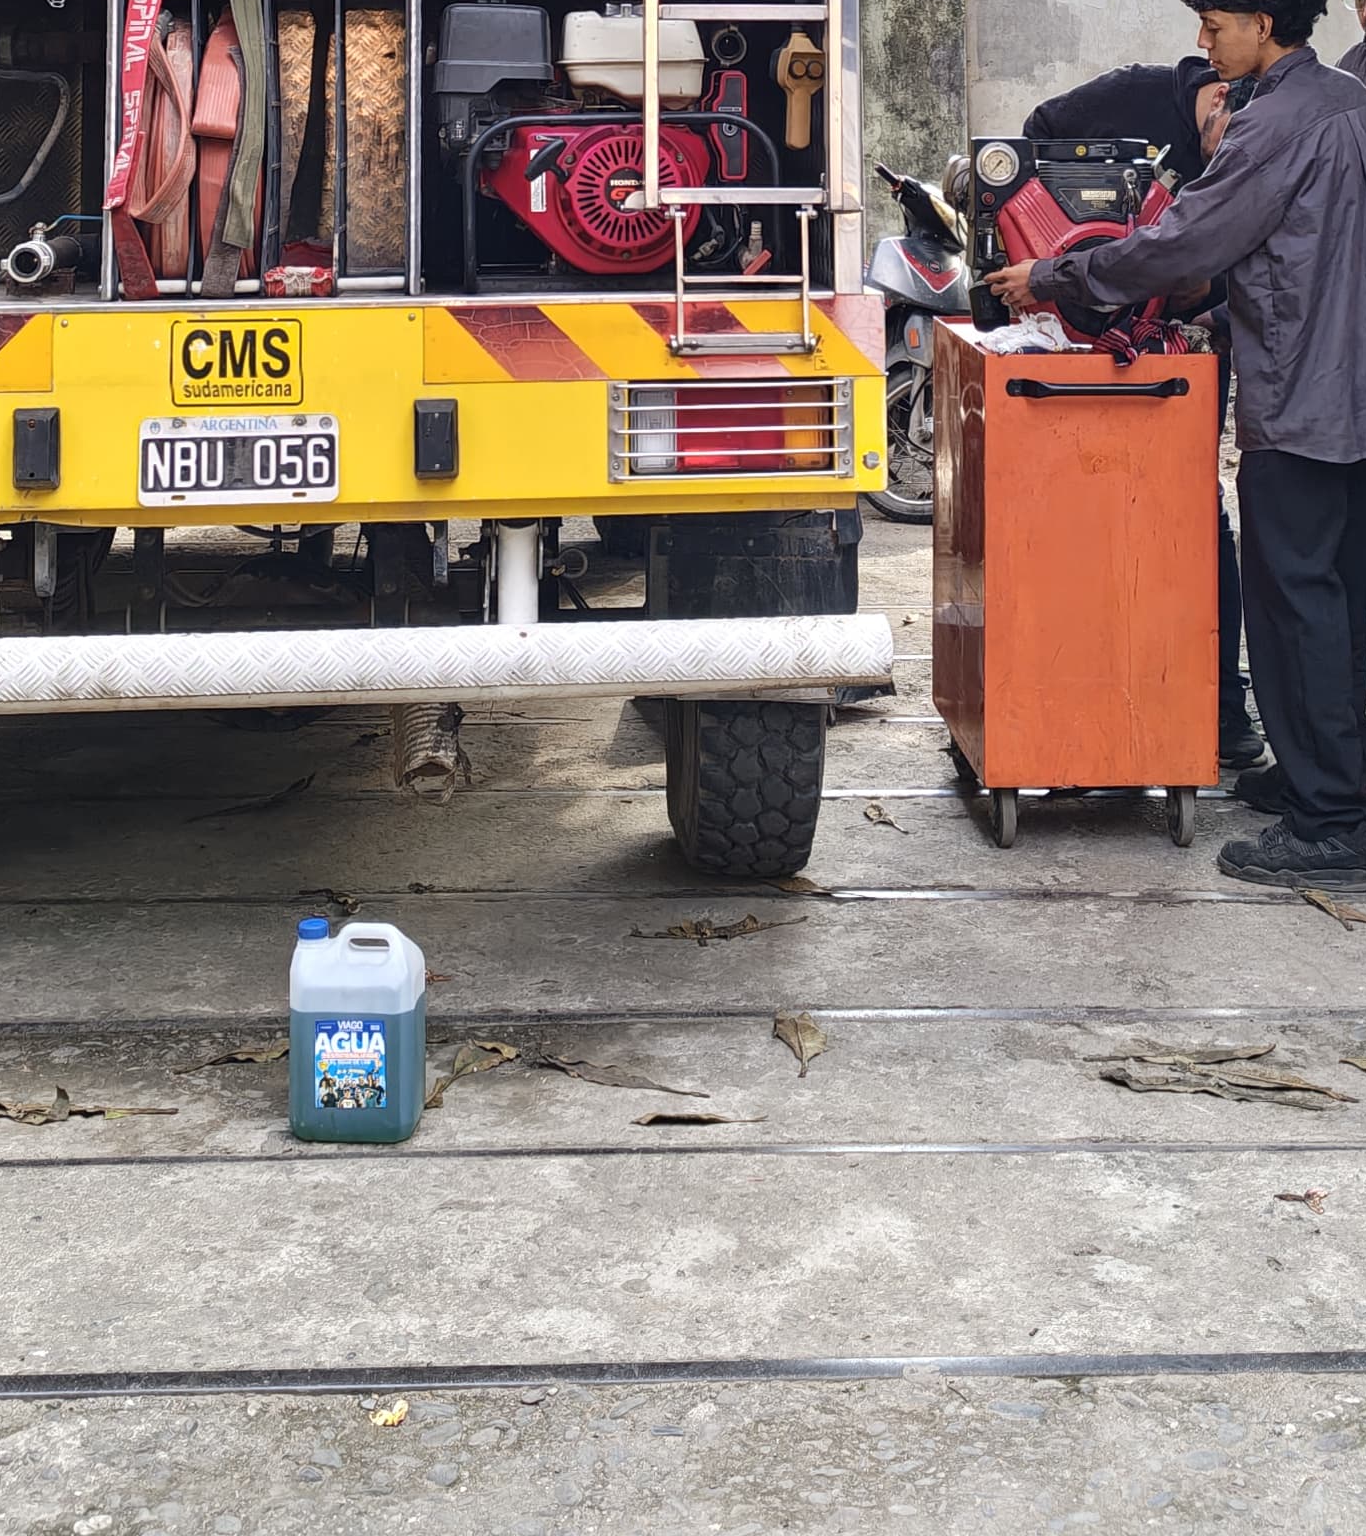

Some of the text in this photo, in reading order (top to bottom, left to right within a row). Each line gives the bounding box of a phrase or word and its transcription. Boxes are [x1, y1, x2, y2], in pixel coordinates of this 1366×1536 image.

[182, 328, 291, 380] CMS
[183, 380, 292, 398] sudamericana
[199, 418, 278, 431] ARGENTINA
[147, 437, 331, 489] NBU 056
[315, 1031, 386, 1055] AGUA
